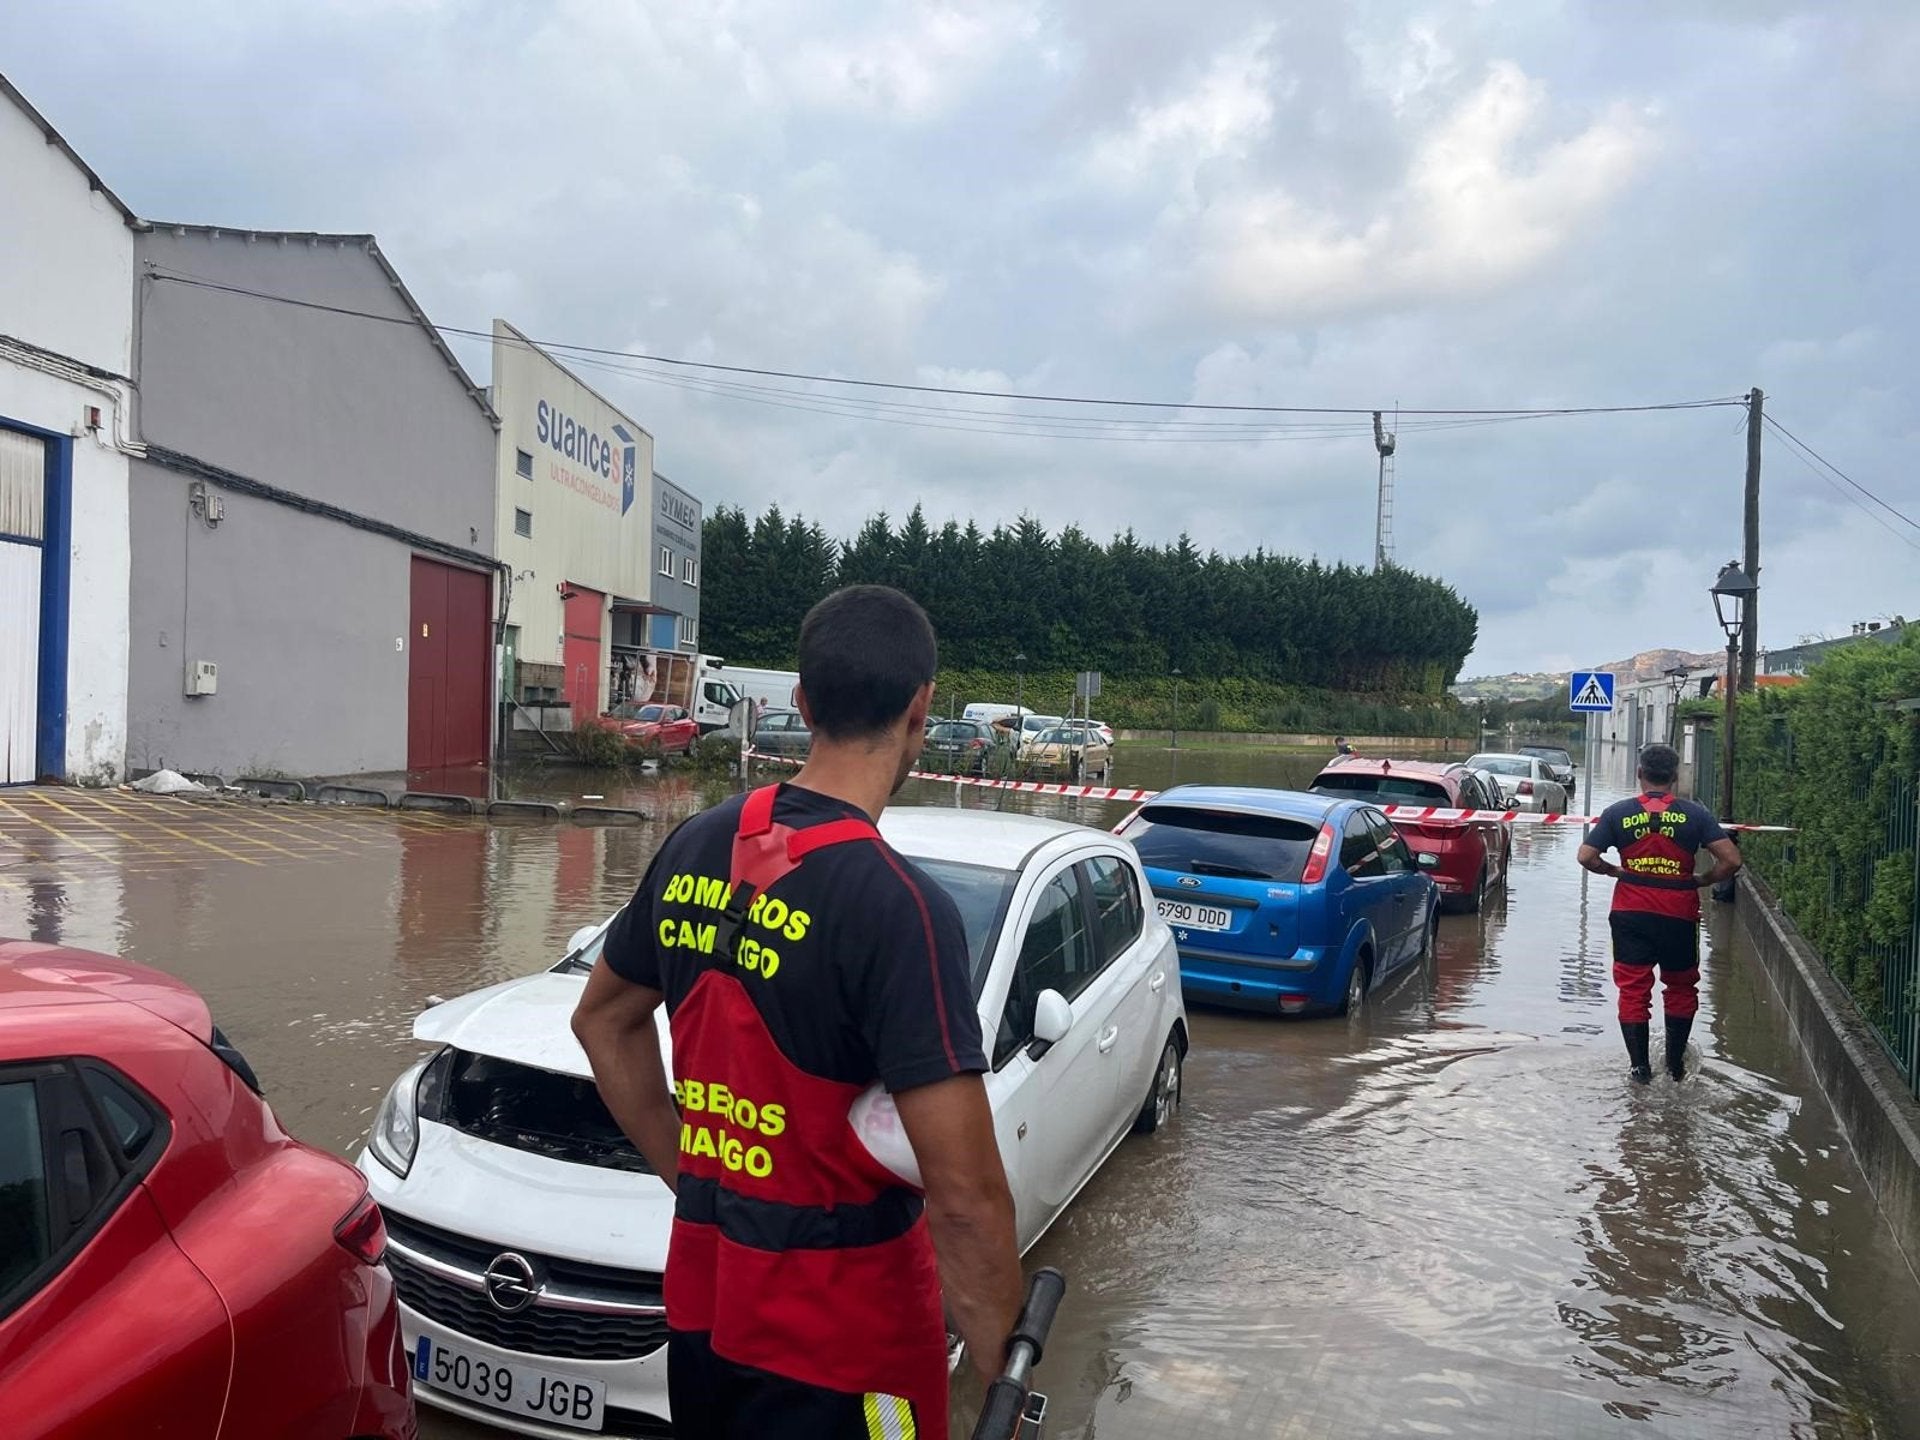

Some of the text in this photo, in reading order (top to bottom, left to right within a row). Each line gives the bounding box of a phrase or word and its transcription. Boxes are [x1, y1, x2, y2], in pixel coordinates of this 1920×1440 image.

[537, 399, 621, 484] suances
[661, 491, 695, 528] SYMEC
[1622, 811, 1686, 829] BOMROS
[662, 874, 811, 941] BOMROS
[1157, 901, 1192, 920] 6790
[1198, 908, 1226, 926] DDD
[659, 918, 780, 979] CAMGO
[434, 1346, 594, 1421] 5039 JGB
